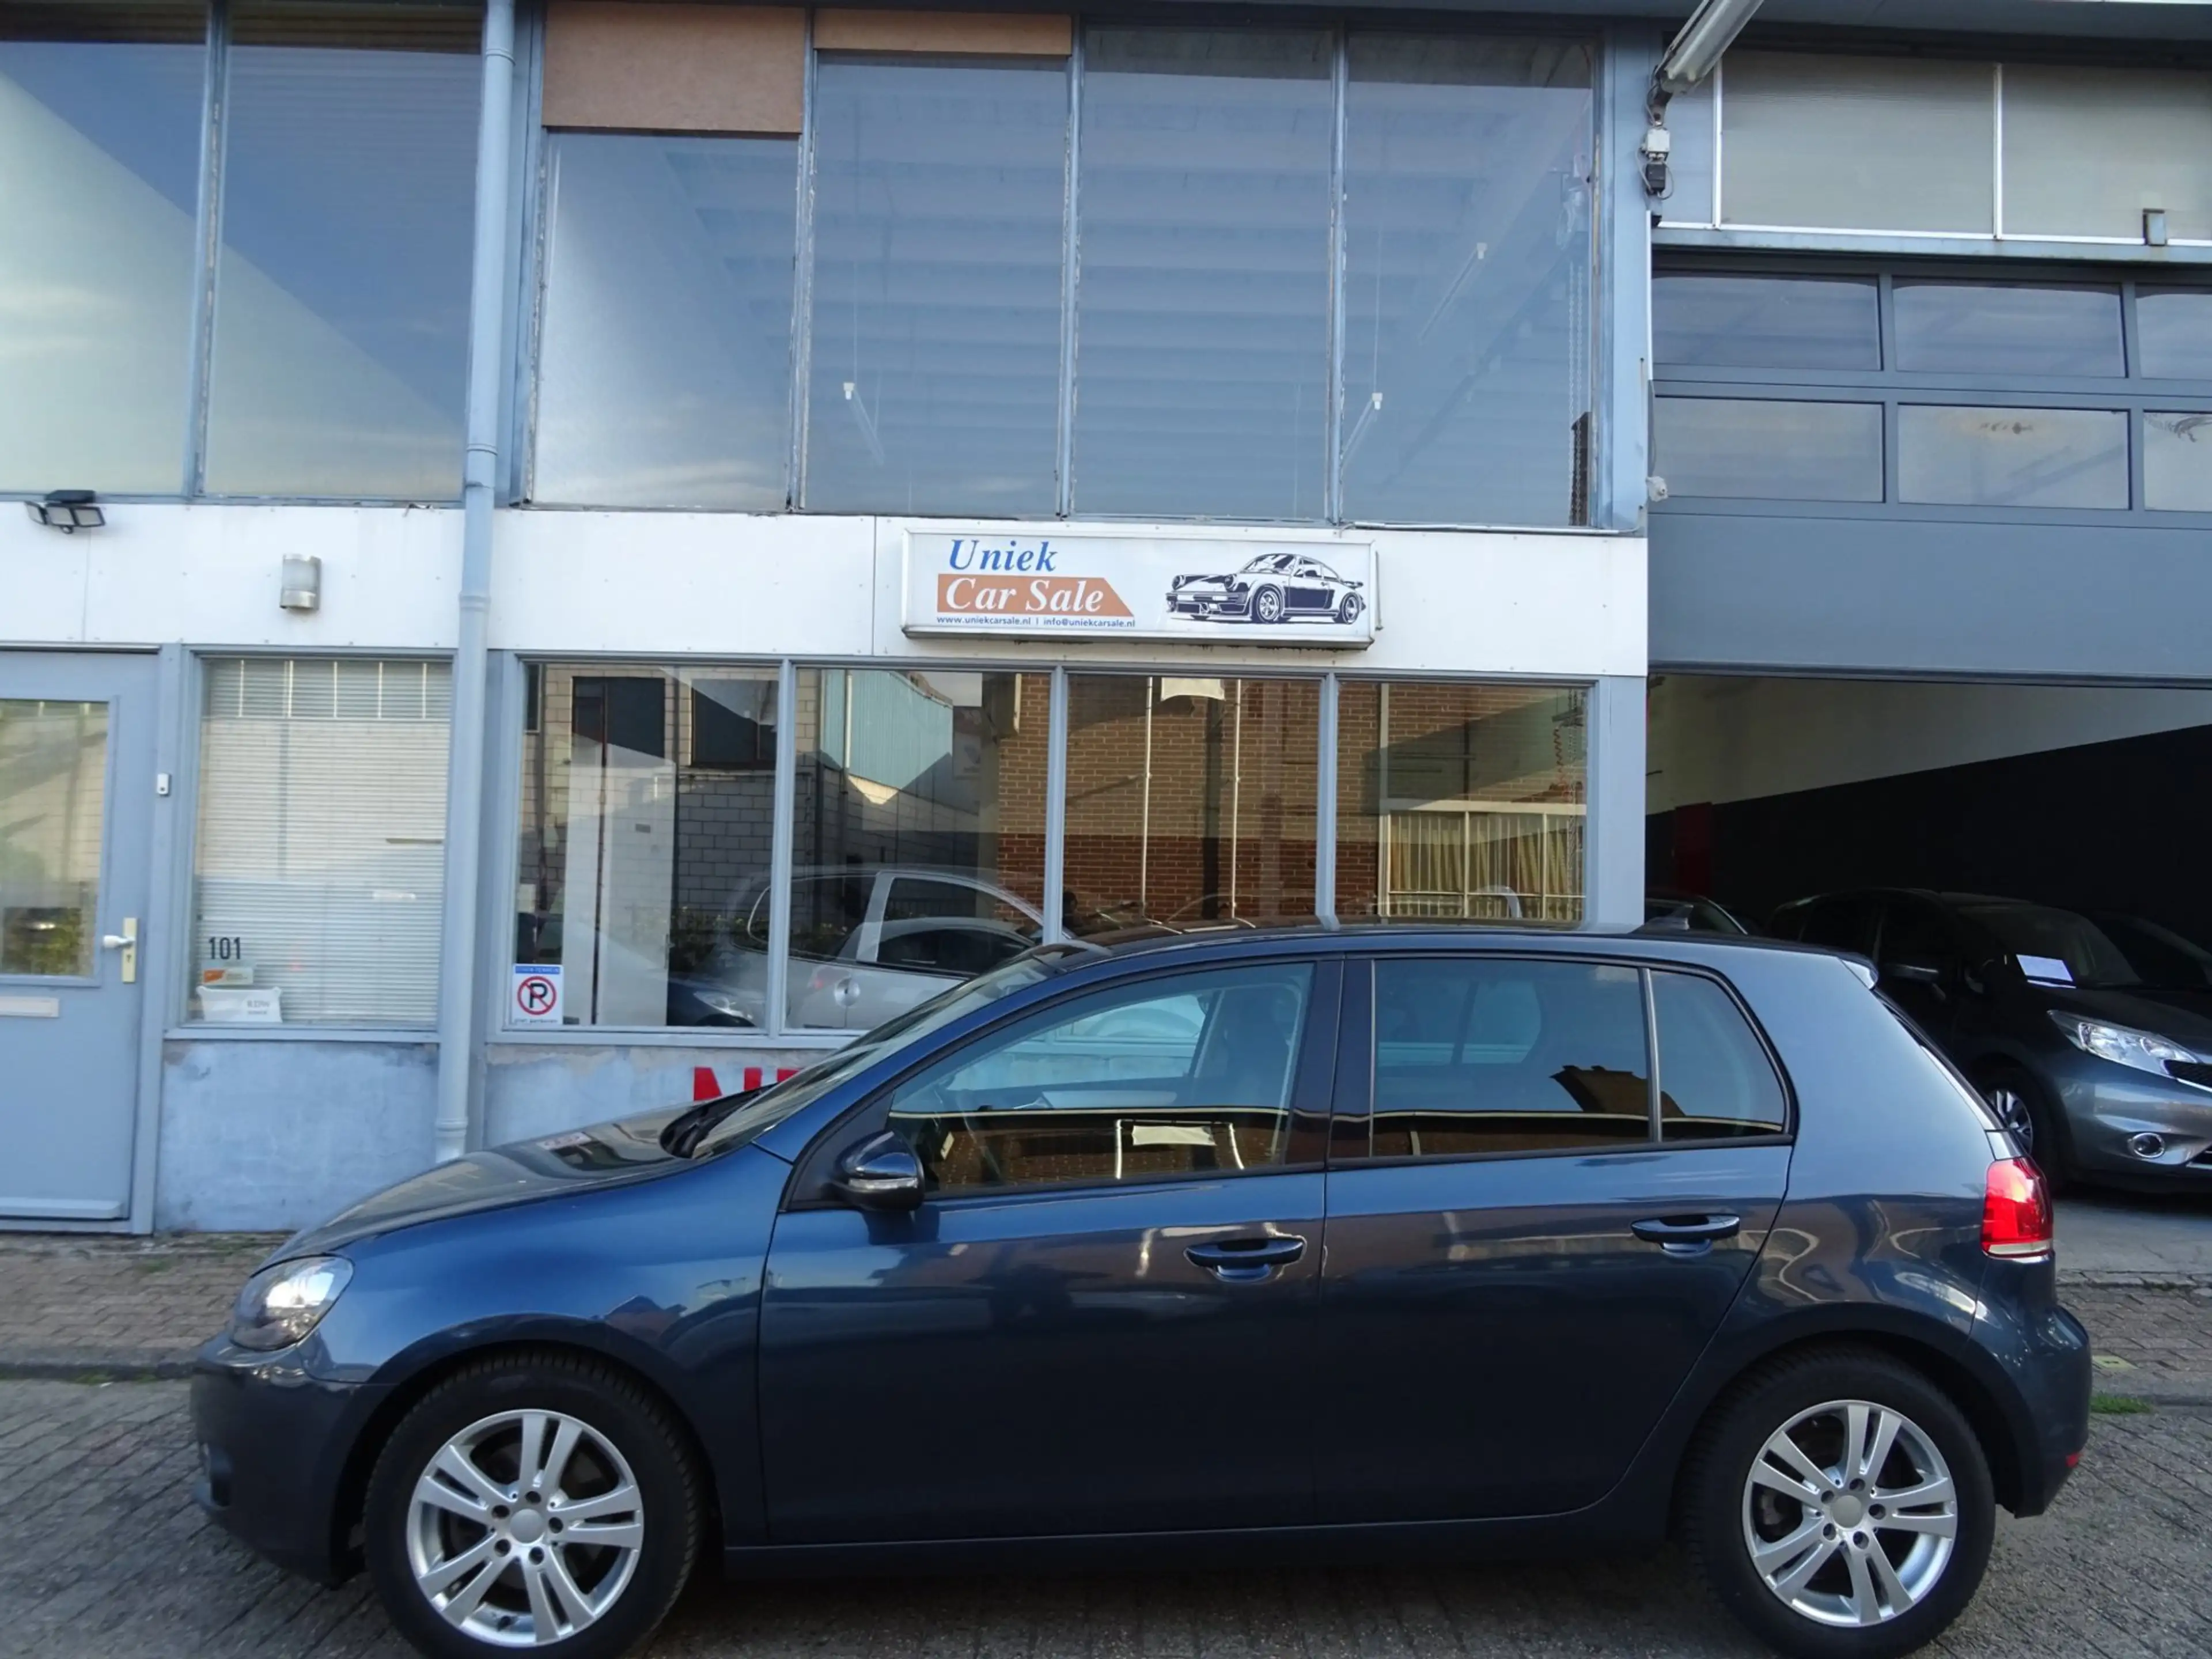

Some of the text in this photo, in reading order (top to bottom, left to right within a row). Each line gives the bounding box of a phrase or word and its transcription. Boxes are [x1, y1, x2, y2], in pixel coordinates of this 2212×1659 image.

[949, 539, 1059, 572] Uniek
[945, 577, 1104, 612] Car Sale
[936, 615, 1031, 626] www.uniekcarsale.nl
[1043, 617, 1136, 628] info@uniekcarsale.nl
[208, 937, 241, 960] 101
